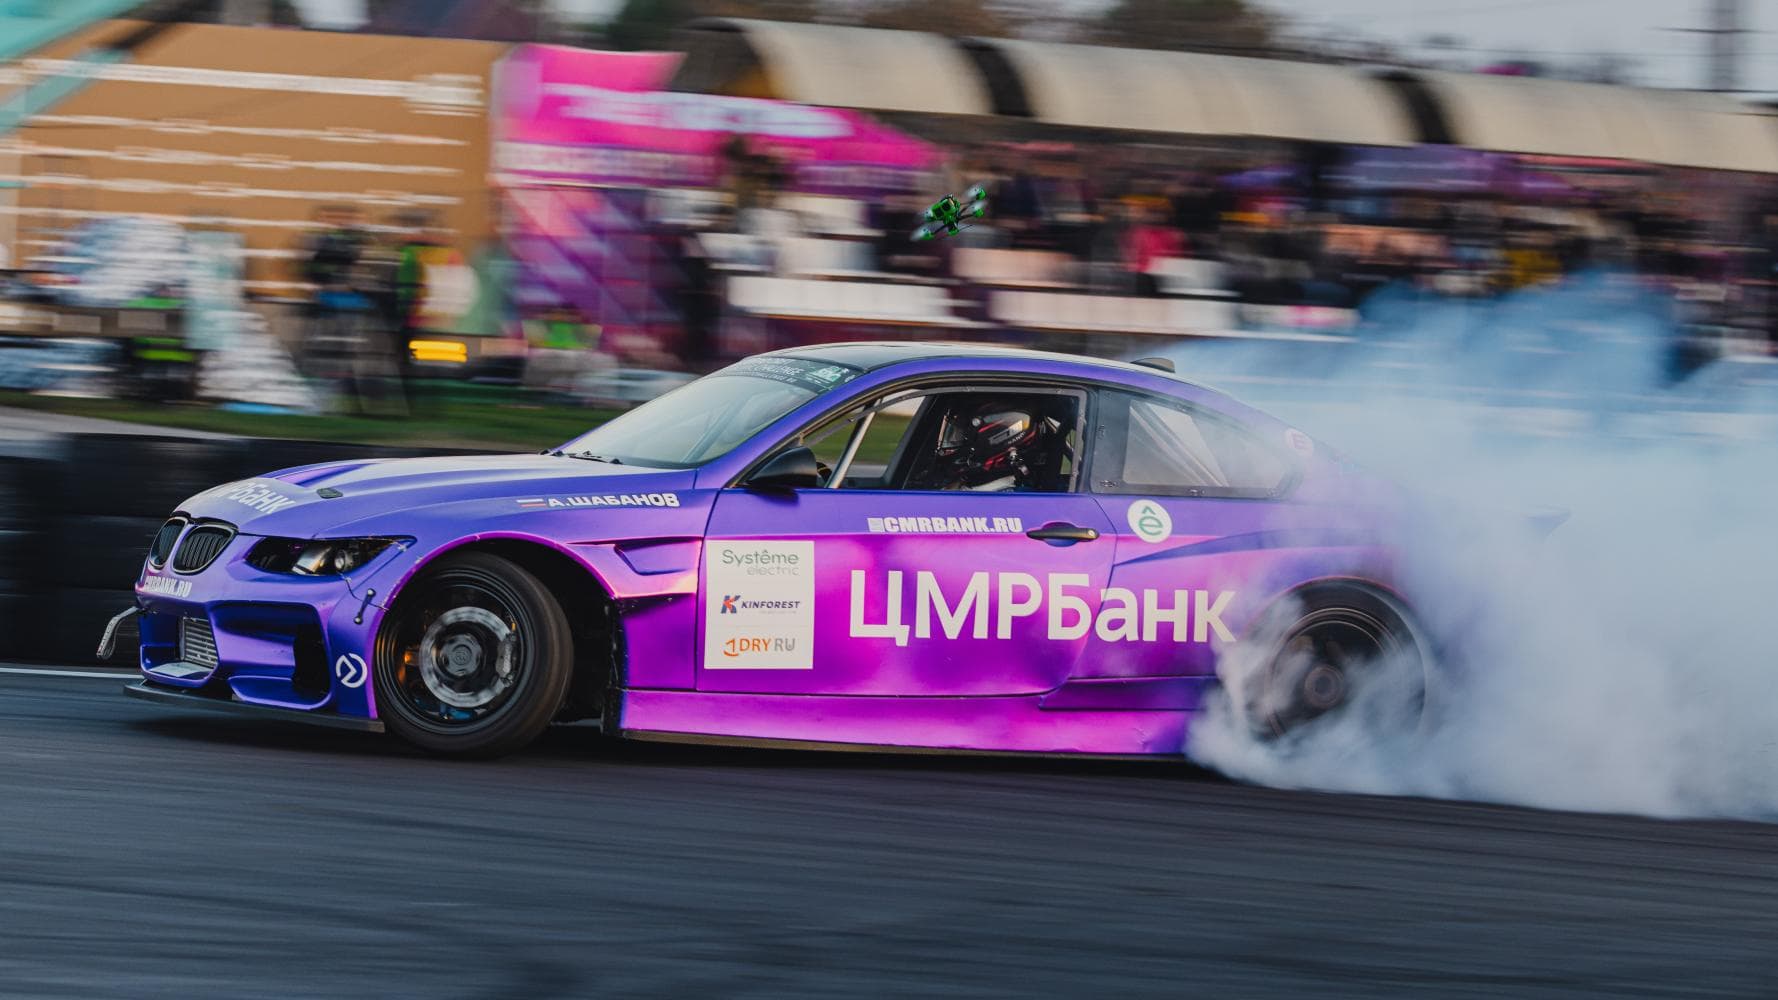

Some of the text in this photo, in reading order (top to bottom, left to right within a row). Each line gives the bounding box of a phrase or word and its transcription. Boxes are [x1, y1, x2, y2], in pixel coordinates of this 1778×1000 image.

[549, 493, 680, 508] А.ШАБАНОВ
[883, 517, 1023, 533] CMRBANK.RU
[722, 548, 799, 566] Systême
[746, 564, 800, 576] electric
[741, 600, 800, 609] KINFOREST
[849, 569, 1237, 647] ЦМРБанк
